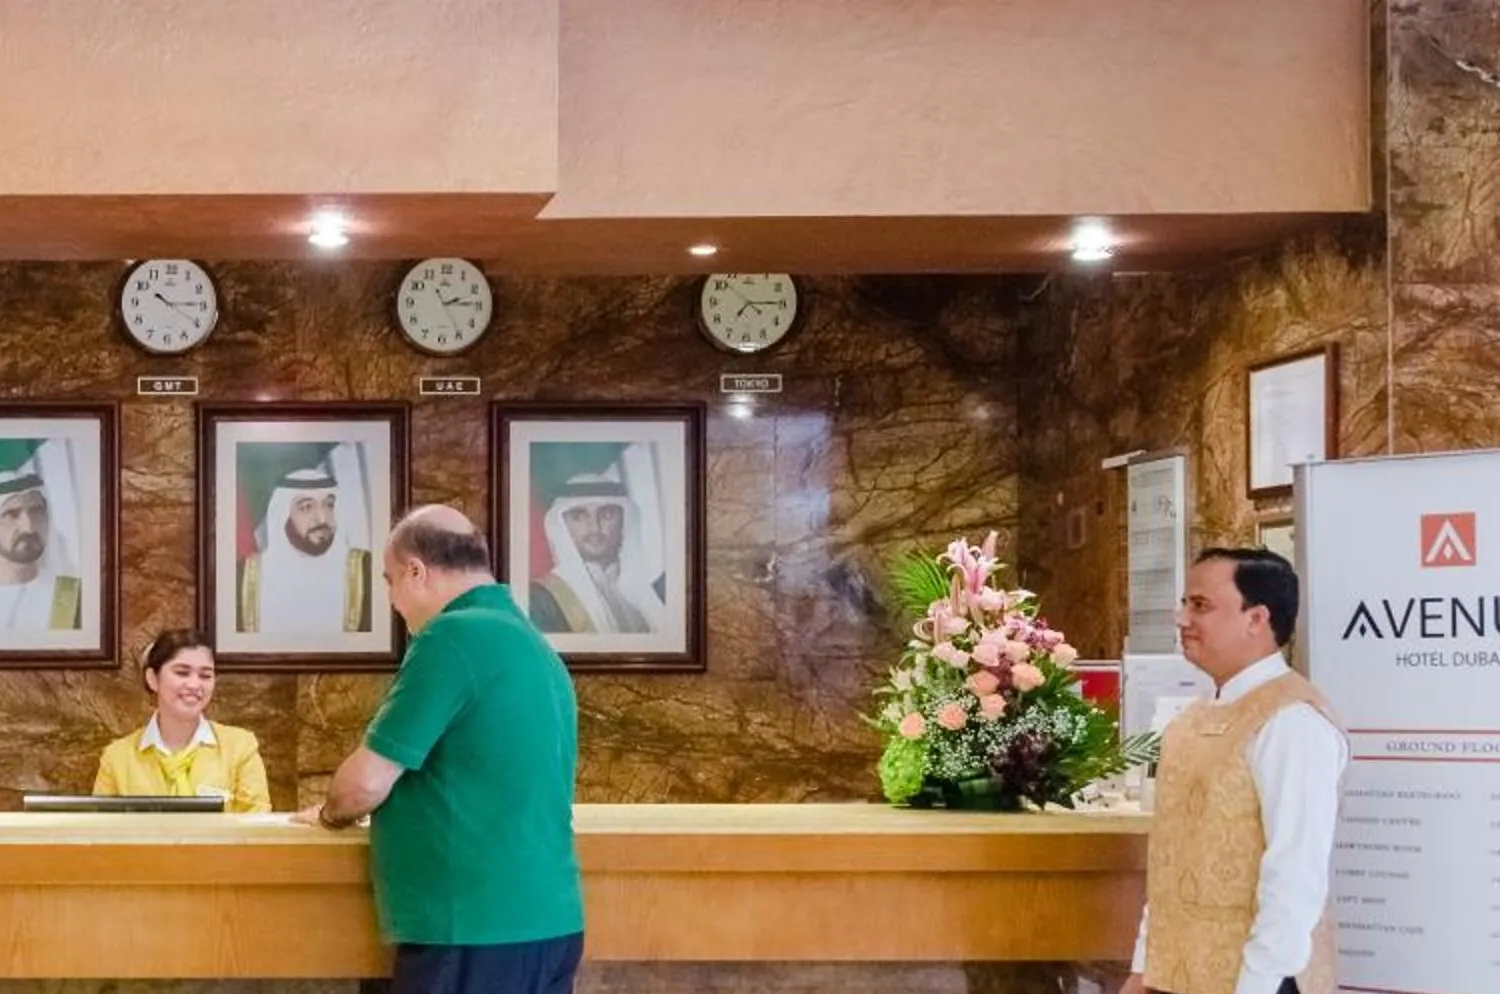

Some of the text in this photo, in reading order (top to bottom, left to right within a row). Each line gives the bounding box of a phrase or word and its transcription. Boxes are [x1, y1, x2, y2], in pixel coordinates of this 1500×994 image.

[153, 382, 182, 391] GMT
[435, 381, 464, 391] UAE
[734, 379, 769, 389] TOKYO
[1342, 595, 1500, 641] AVEN
[1395, 652, 1448, 667] HOTEL
[1386, 740, 1456, 753] GROUND
